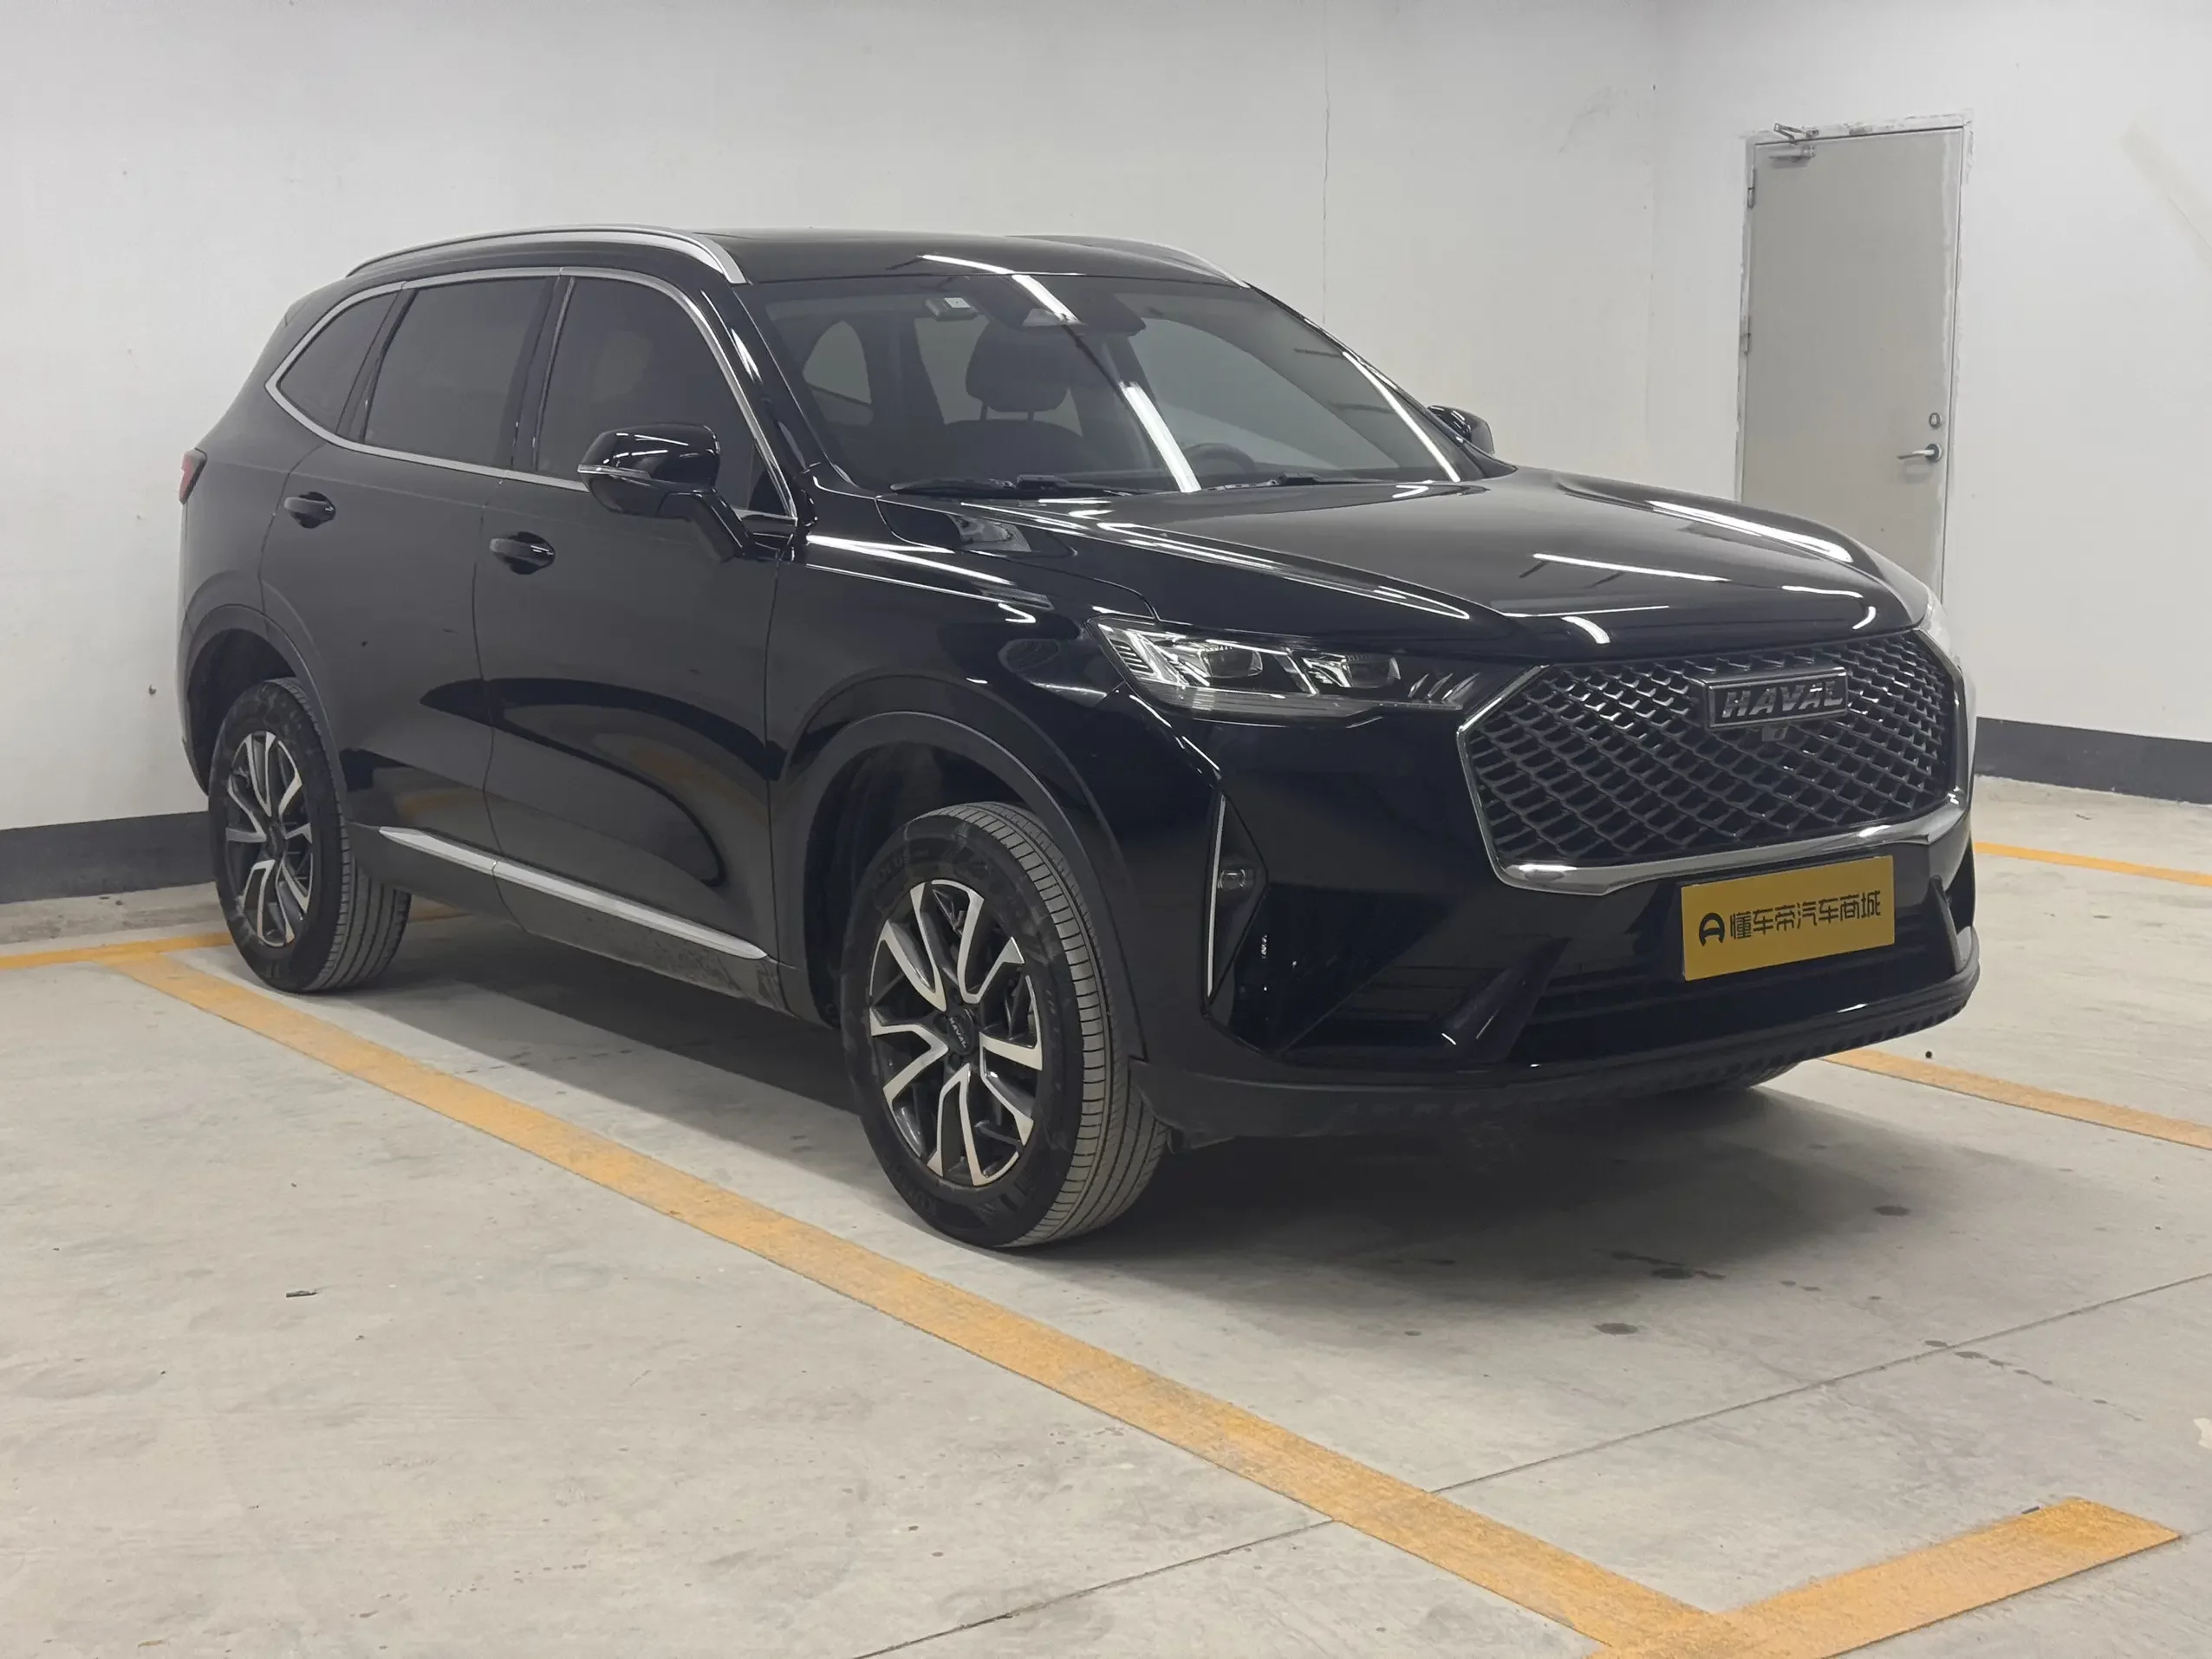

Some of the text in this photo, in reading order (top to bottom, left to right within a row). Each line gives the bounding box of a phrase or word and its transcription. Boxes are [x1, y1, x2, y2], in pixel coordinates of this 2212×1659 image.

[1721, 680, 1843, 718] HAVAL
[1729, 890, 1881, 940] 懂车帝汽车商城
[949, 1017, 966, 1048] HAVAL
